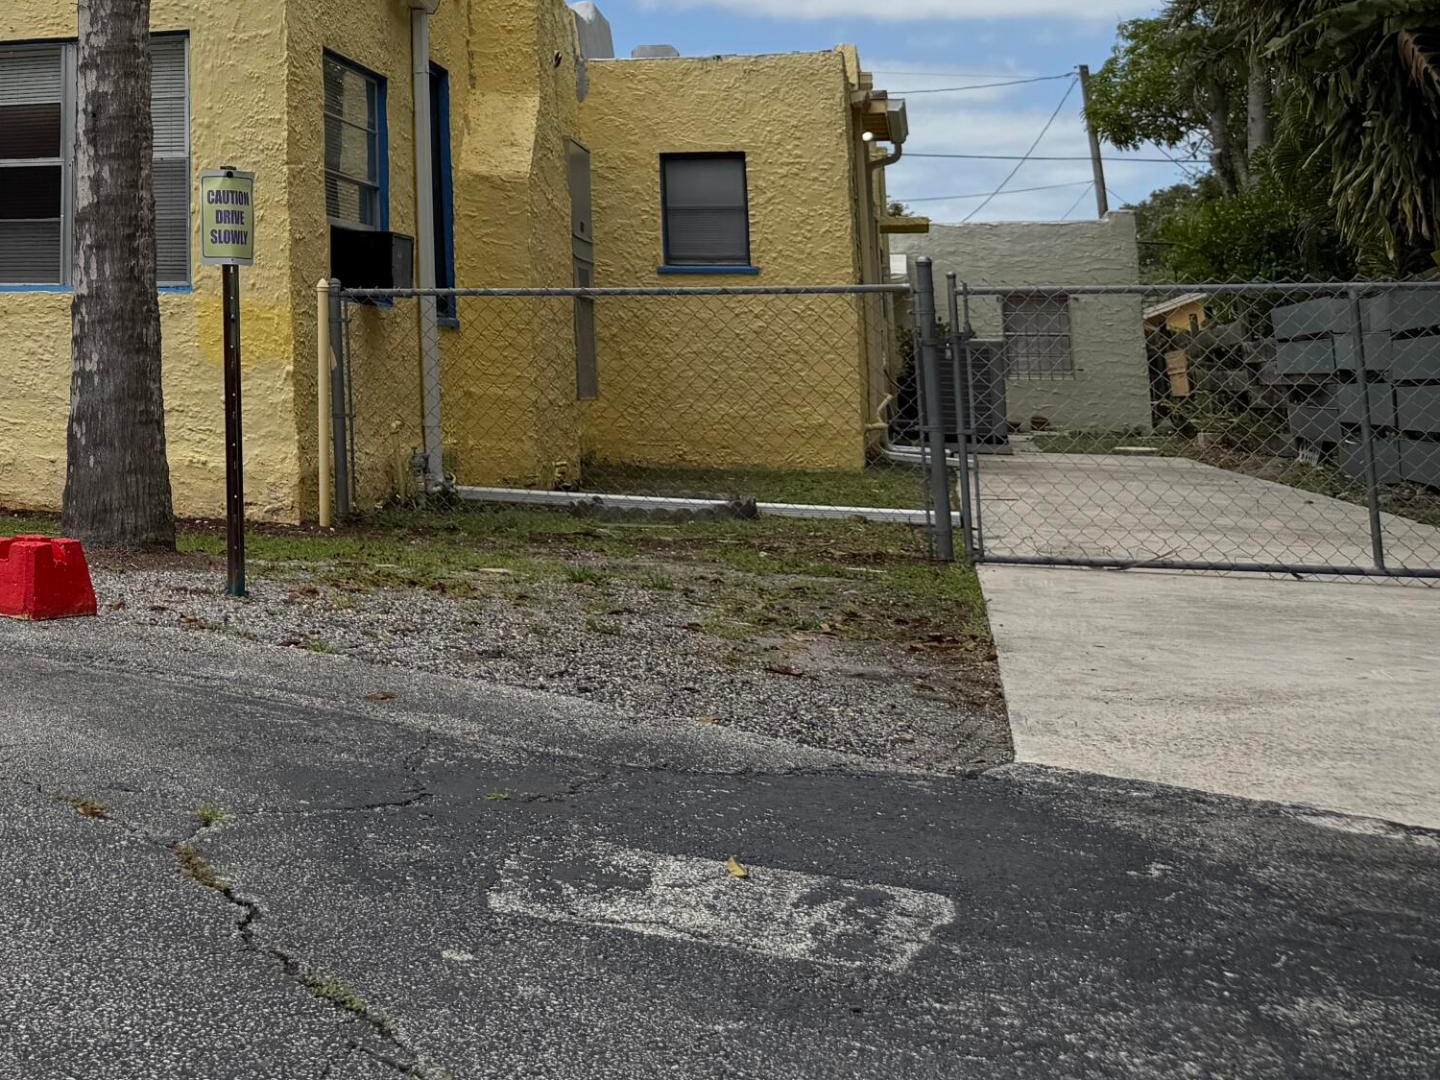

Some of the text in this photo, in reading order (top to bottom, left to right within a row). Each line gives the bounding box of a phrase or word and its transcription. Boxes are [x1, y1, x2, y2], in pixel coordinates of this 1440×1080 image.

[207, 189, 249, 206] CAUTION
[215, 209, 245, 225] DRIVE
[210, 229, 248, 245] SLOWLY
